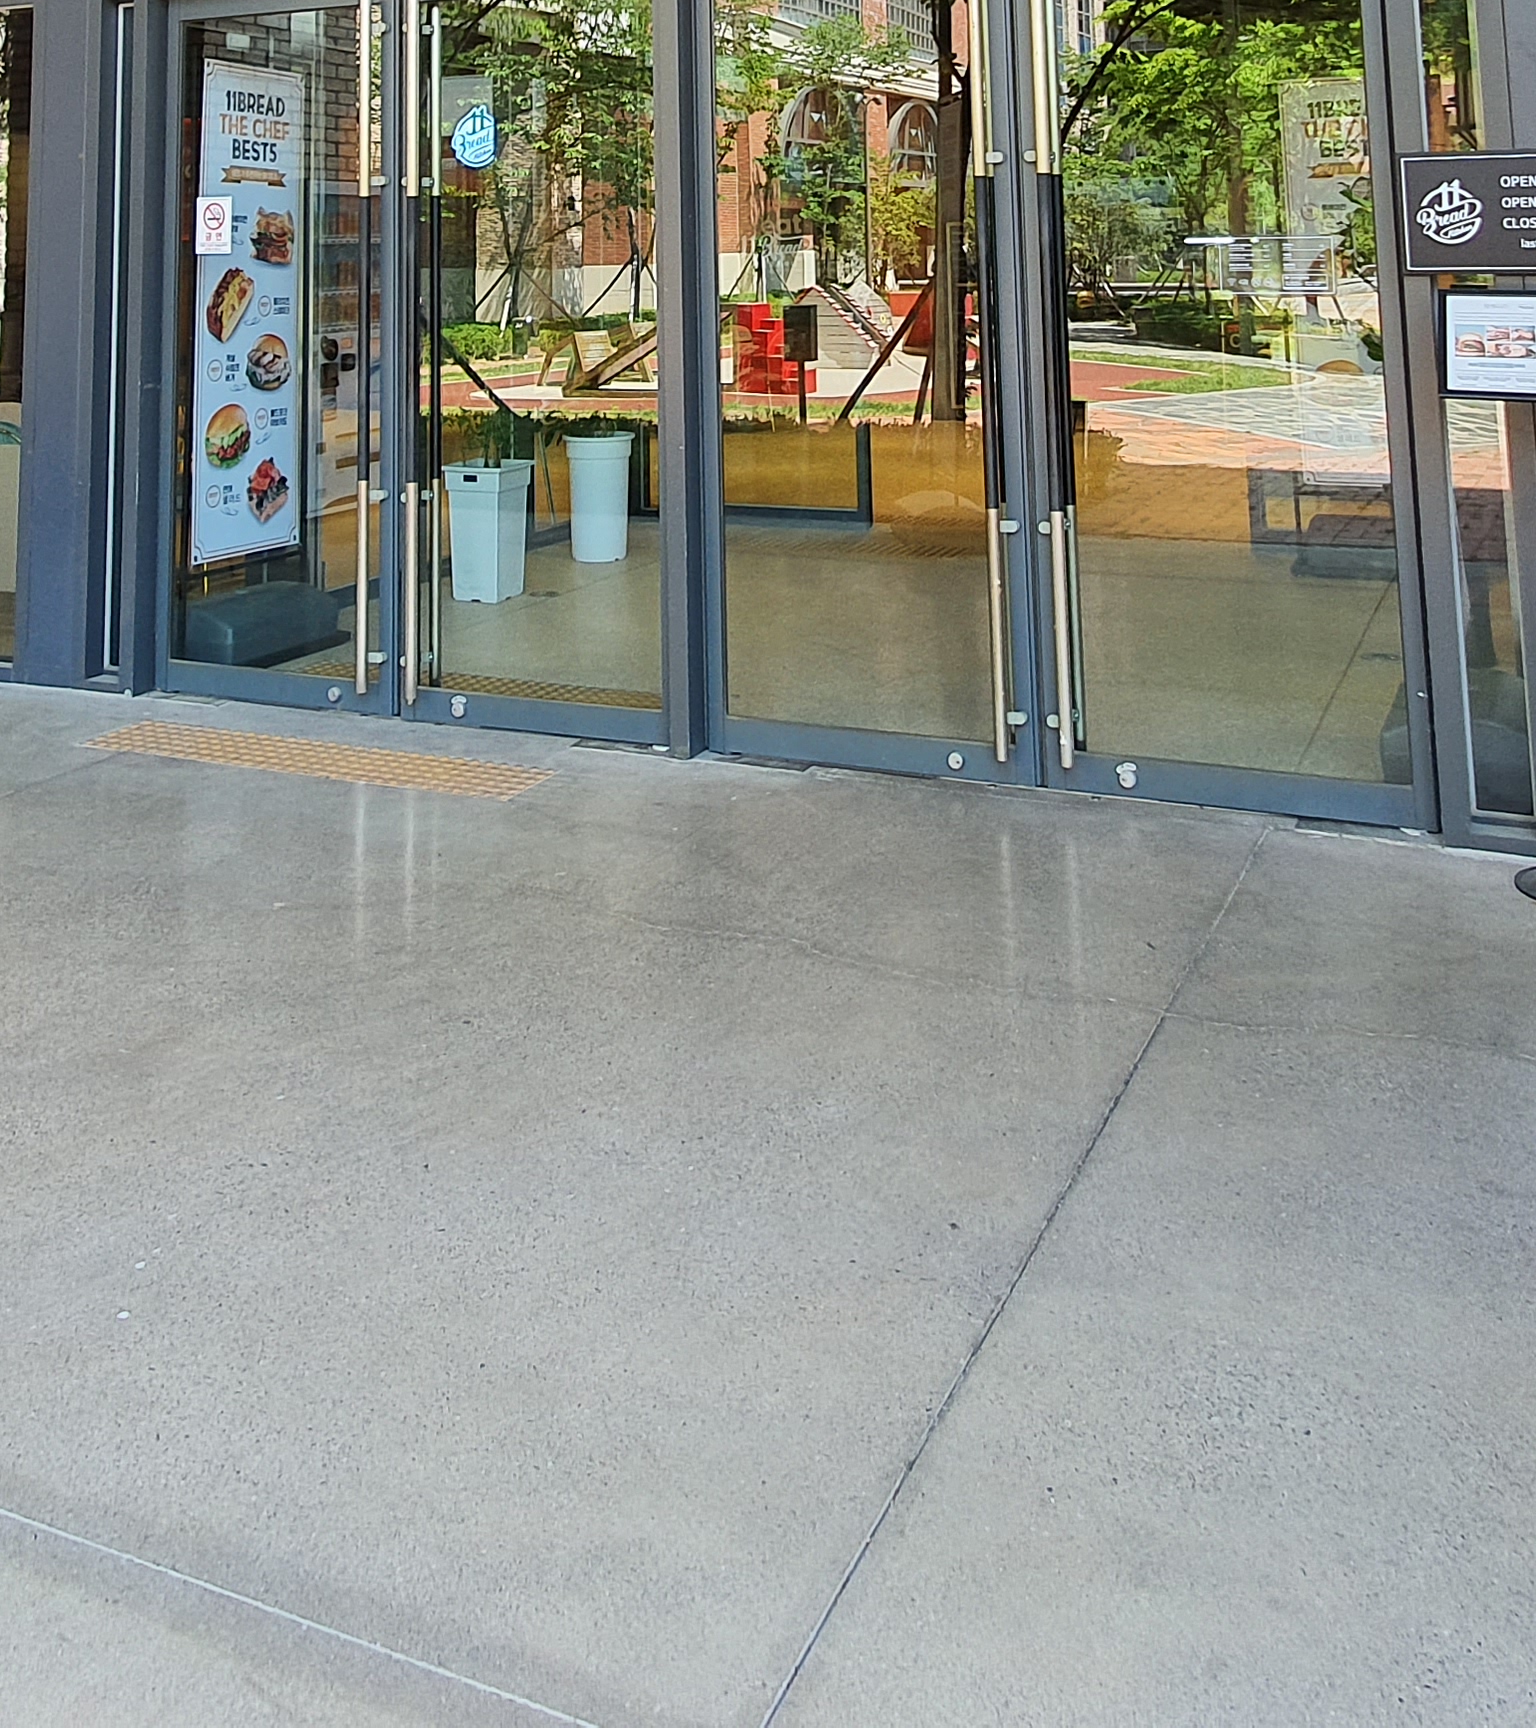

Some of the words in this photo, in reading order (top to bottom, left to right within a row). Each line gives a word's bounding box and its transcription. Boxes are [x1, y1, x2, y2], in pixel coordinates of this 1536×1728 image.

[225, 89, 286, 118] 11BREAD
[219, 112, 249, 137] THE
[252, 117, 291, 141] CHEF
[231, 137, 278, 164] BEST5
[1416, 198, 1483, 235] Bread
